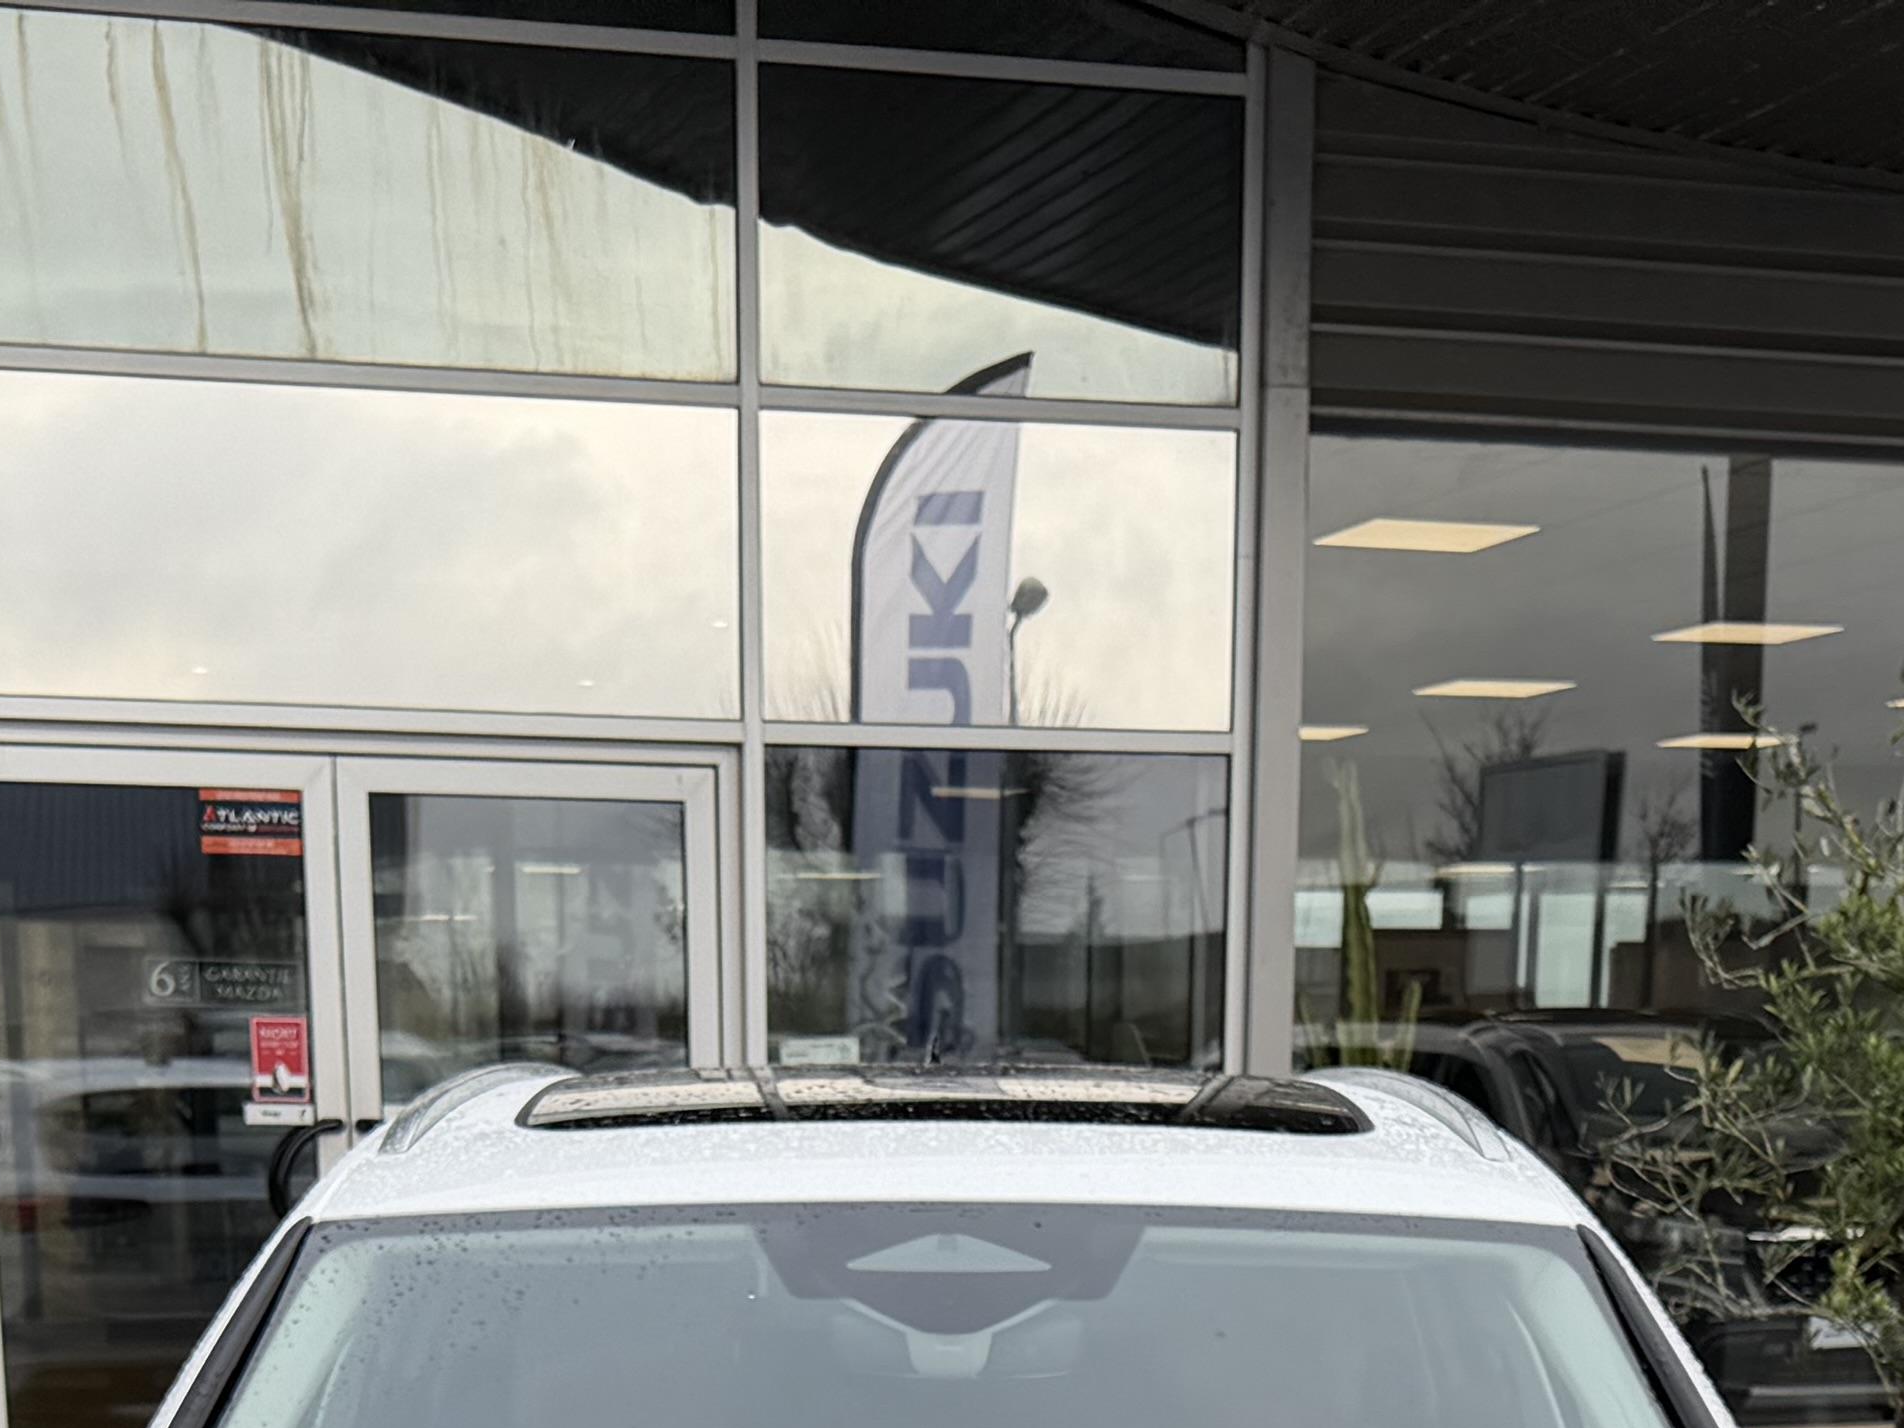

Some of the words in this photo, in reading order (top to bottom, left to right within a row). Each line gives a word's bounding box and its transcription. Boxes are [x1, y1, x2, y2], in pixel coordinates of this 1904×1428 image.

[897, 489, 986, 1056] SUZUKI
[202, 805, 300, 824] ATLANTIC
[150, 961, 176, 997] 6
